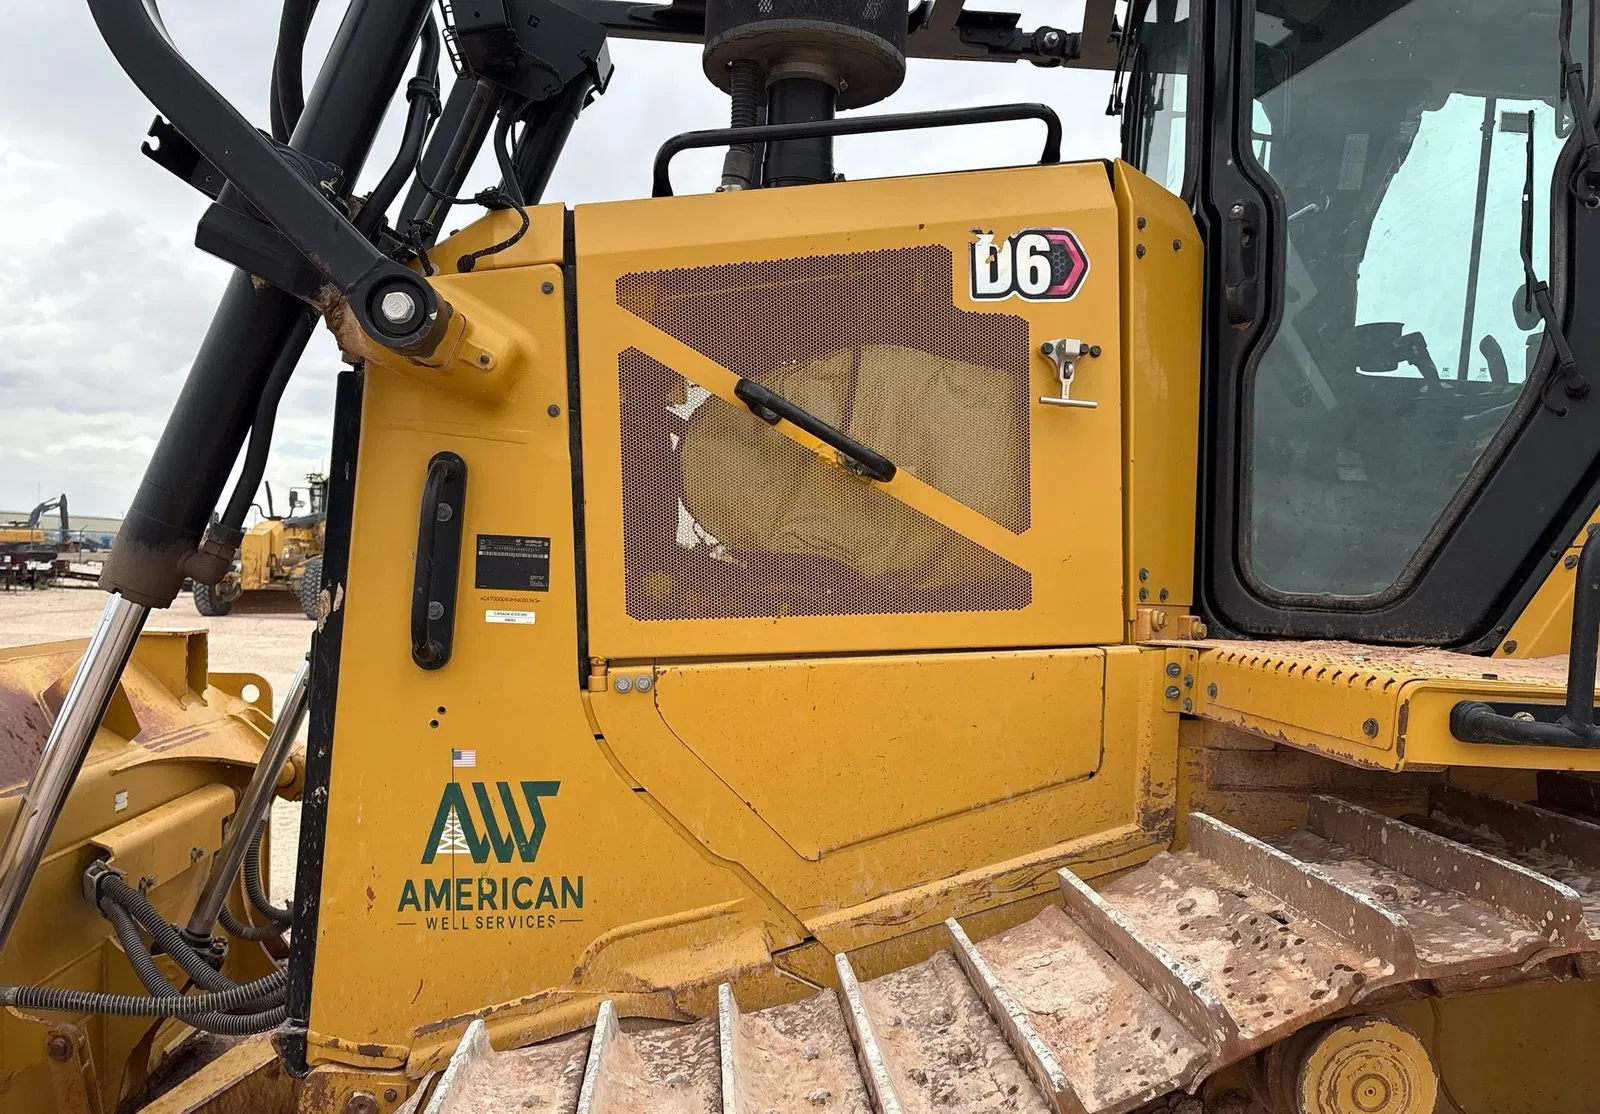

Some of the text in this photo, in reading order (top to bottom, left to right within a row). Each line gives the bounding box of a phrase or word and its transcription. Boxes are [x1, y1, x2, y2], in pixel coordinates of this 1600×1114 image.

[975, 234, 1052, 295] D6
[421, 781, 561, 864] AWS
[397, 876, 584, 912] AMERICAN
[426, 915, 556, 931] WELL SERVICES
